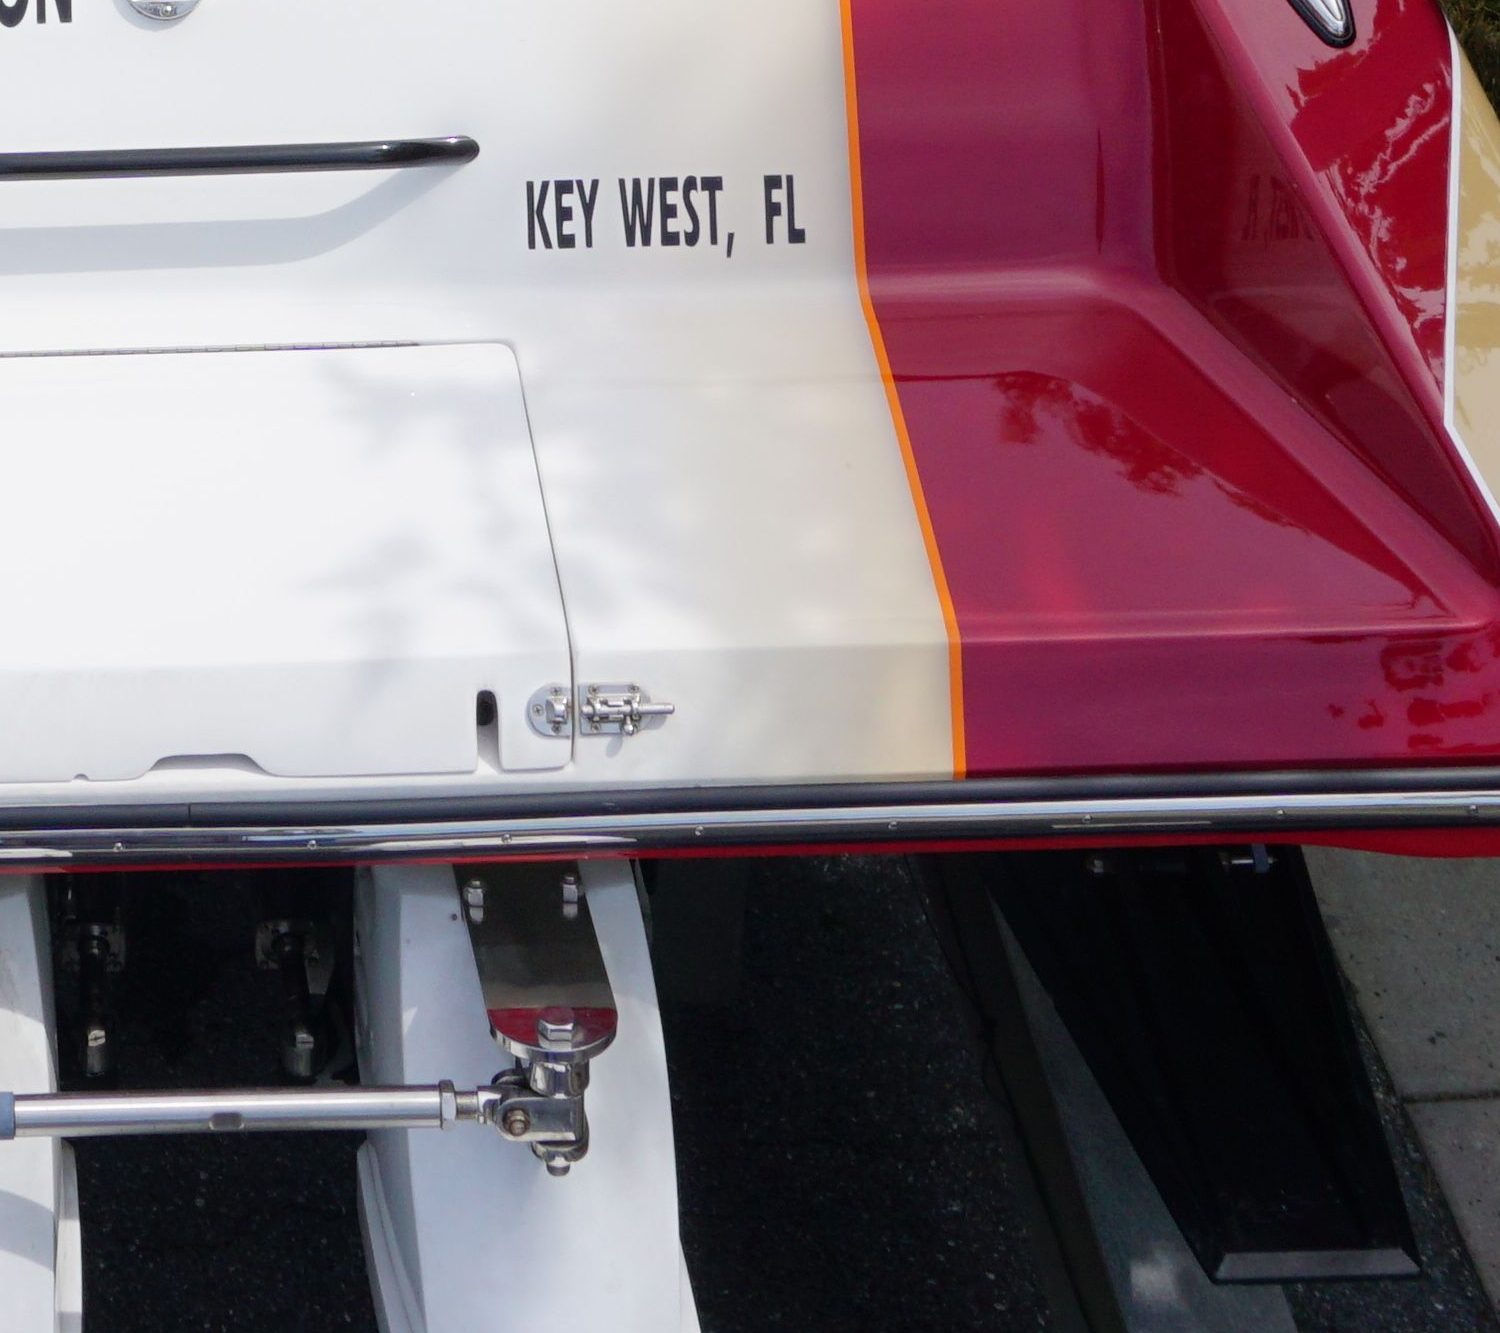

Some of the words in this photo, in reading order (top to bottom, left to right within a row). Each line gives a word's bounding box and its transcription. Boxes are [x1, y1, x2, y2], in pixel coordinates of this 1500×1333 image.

[525, 178, 600, 250] KEY
[618, 175, 735, 259] WEST,
[763, 174, 806, 245] FL
